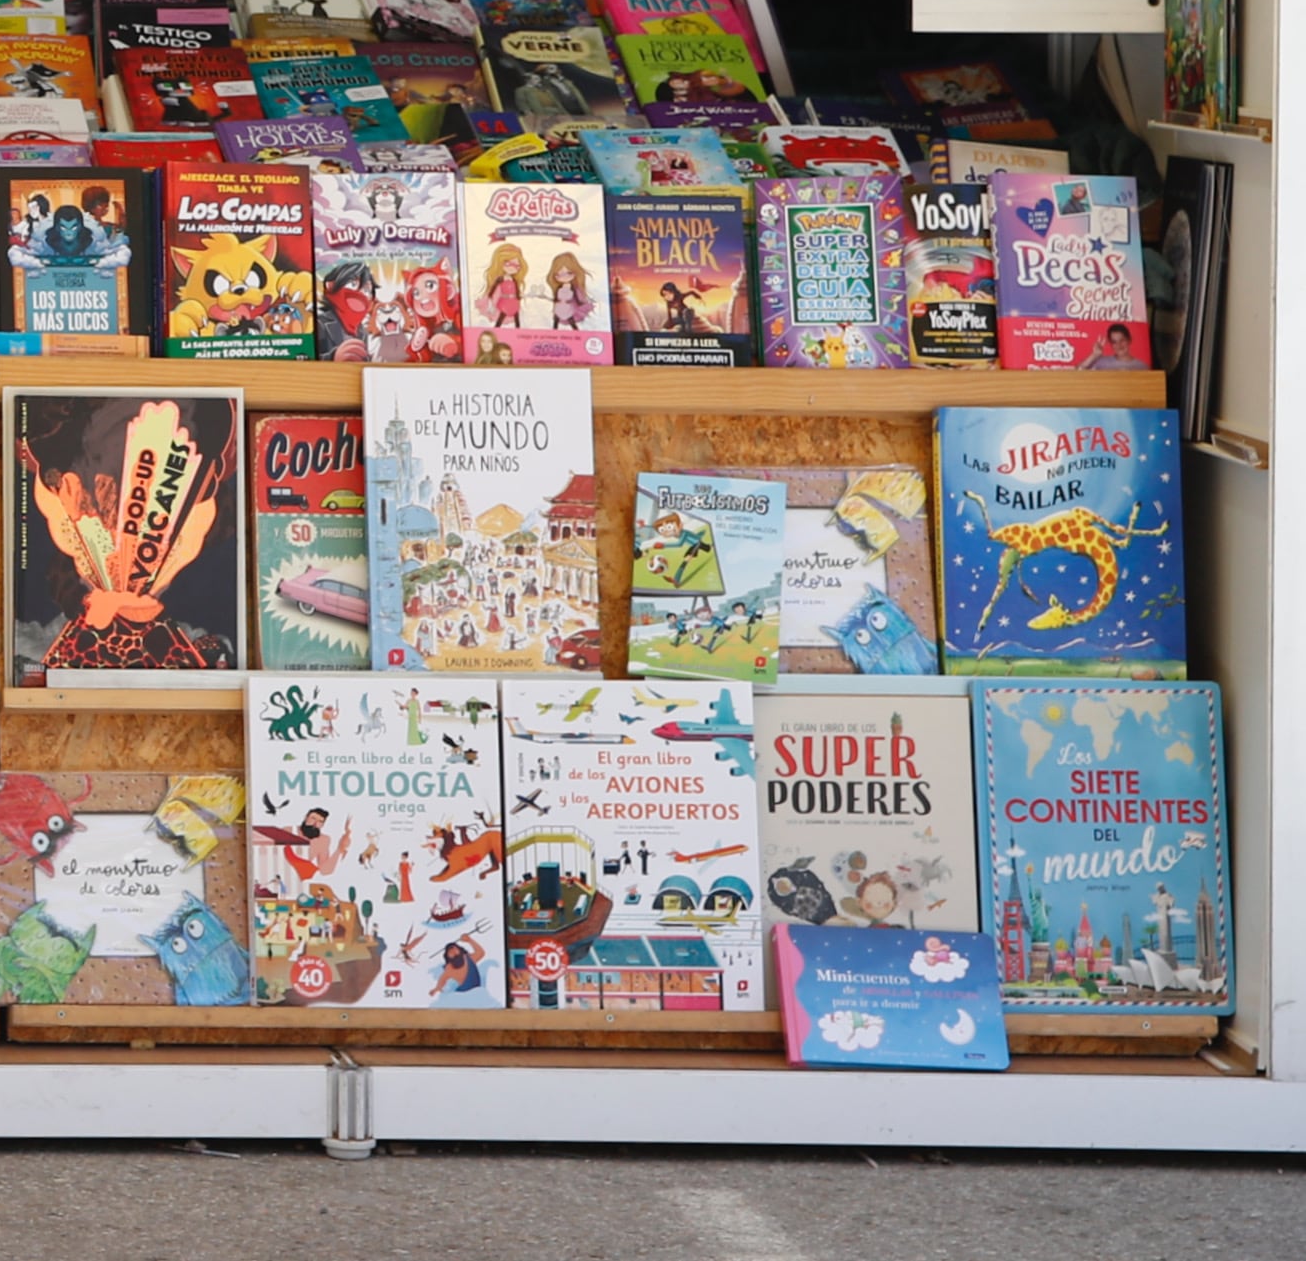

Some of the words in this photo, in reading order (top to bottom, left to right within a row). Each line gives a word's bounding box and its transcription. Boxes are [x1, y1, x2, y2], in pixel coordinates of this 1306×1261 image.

[509, 40, 583, 52] VERNE
[247, 122, 325, 134] PERROCK
[236, 128, 347, 149] HOLMES
[178, 197, 217, 221] LOS
[222, 197, 302, 223] COMPAS
[630, 217, 720, 237] AMANDA
[636, 239, 721, 271] BLACK
[1048, 238, 1087, 256] Lady
[1016, 242, 1124, 286] Pecas
[32, 292, 56, 310] LOS
[60, 292, 108, 310] DIOSES
[32, 310, 57, 331] MÁS
[61, 312, 109, 331] LOCOS
[963, 453, 990, 474] LAS
[996, 426, 1132, 475] JIRAFAS
[124, 448, 154, 536] POP-UP
[996, 479, 1084, 511] BAILAR
[130, 441, 190, 582] VOLCANES
[307, 751, 321, 765] El
[325, 754, 358, 768] gran
[362, 751, 395, 765] libro
[399, 751, 412, 765] de
[418, 751, 432, 765] la
[598, 751, 611, 765] El
[616, 752, 652, 768] gran
[657, 751, 692, 765] libro
[773, 735, 922, 779] SUPER
[1057, 743, 1093, 767] Los
[278, 768, 474, 798] MITOLOGÍA
[568, 768, 585, 780] de
[588, 768, 605, 780] los
[1070, 770, 1140, 795] SIETE
[606, 776, 705, 794] AVIONES
[559, 794, 567, 806] y
[571, 792, 589, 804] los
[767, 779, 932, 816] PODERES
[377, 801, 426, 816] griega
[587, 802, 739, 820] AEROPUERTOS
[1004, 798, 1209, 824] CONTINENTES
[1093, 828, 1120, 842] DEL
[1044, 825, 1182, 884] mundo
[63, 860, 79, 877] el
[85, 860, 177, 877] monstruo
[80, 879, 96, 896] de
[102, 880, 160, 897] colores
[536, 951, 559, 971] 50
[298, 969, 324, 988] 40
